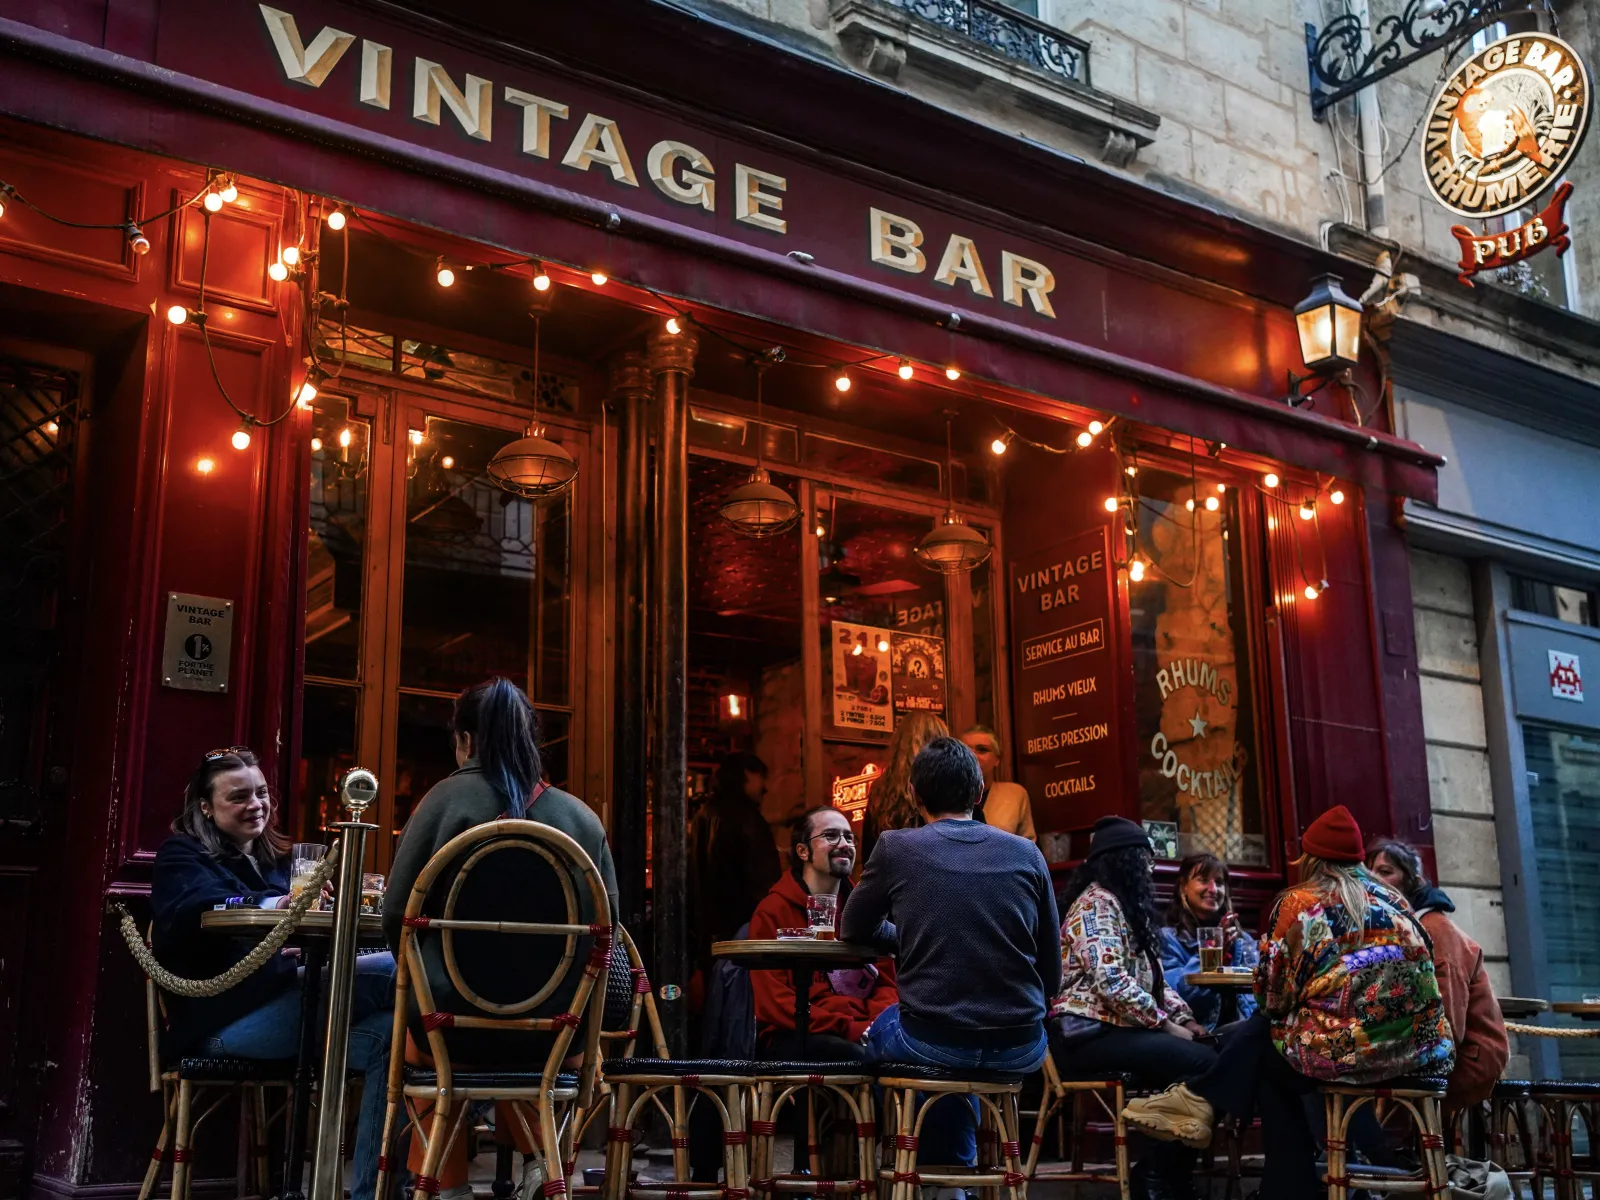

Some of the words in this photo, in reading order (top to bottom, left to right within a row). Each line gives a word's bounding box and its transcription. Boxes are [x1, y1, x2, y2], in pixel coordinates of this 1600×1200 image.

[1427, 40, 1521, 151] VINTAGE
[259, 3, 787, 234] VINTAGE
[870, 207, 1056, 319] BAR
[1430, 104, 1577, 207] RHUMERIE
[1472, 217, 1549, 264] PUB
[1018, 551, 1102, 593] VINTAGE
[177, 604, 225, 618] VINTAGE
[1041, 584, 1080, 612] BAR
[188, 615, 212, 626] BAR
[1025, 638, 1062, 662] SERVICE
[1065, 634, 1078, 651] AU
[1080, 628, 1100, 647] BAR
[178, 660, 197, 669] FOR
[197, 662, 215, 671] THE
[178, 667, 214, 677] PLANET
[1156, 658, 1232, 705] RHUMS
[1033, 684, 1066, 706] RHUMS
[1067, 676, 1097, 697] VIEUX
[1027, 734, 1060, 755] BIERES
[1061, 722, 1108, 748] PRESSION
[1151, 732, 1247, 799] COCKTAILS
[1045, 774, 1096, 798] COCKTAILS
